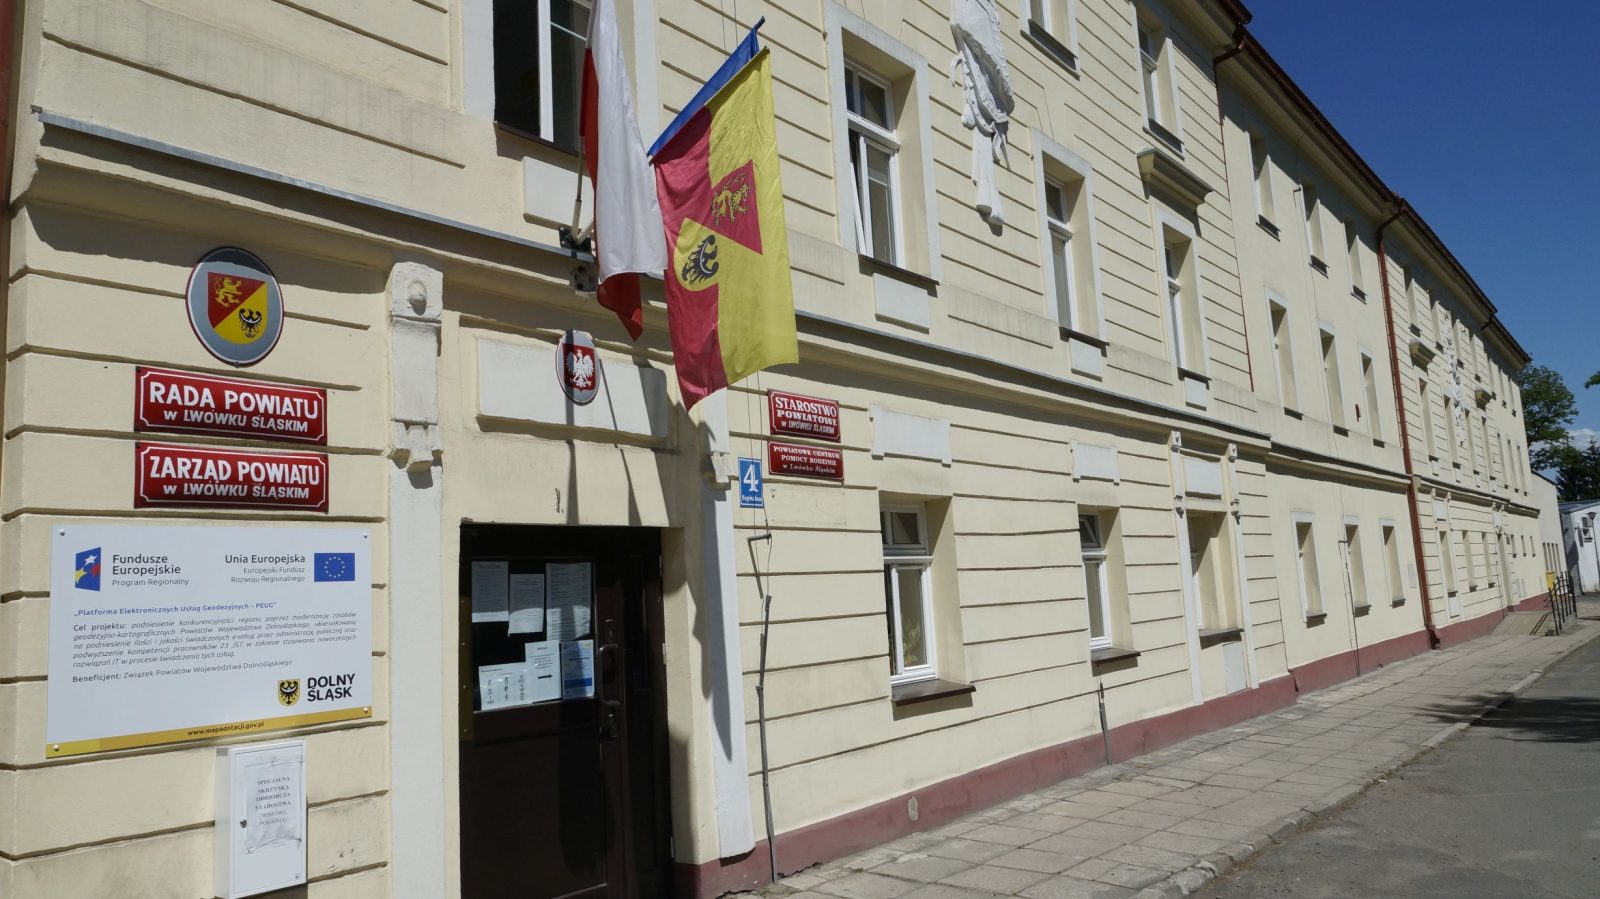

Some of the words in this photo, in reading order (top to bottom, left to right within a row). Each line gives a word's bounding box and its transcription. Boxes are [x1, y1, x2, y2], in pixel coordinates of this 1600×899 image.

[149, 381, 216, 409] RADA
[224, 390, 319, 420] POWIATU
[775, 397, 838, 418] STAROSTWO
[163, 410, 177, 421] w
[183, 408, 247, 427] LWÓWKU
[251, 414, 308, 432] ŚLĄSKIM
[776, 410, 838, 427] POWIATOWE
[788, 420, 812, 430] LWÓWKU
[813, 422, 835, 434] ŚLĄSKIM
[773, 446, 812, 456] POWIATOWE
[812, 450, 841, 460] CENTRUM
[781, 455, 808, 463] POMOCY
[810, 458, 837, 466] RODZINIE
[149, 455, 232, 484] ZARZĄD
[237, 461, 320, 486] POWIATU
[742, 464, 759, 492] 4
[814, 466, 836, 474] Śląskim
[163, 484, 177, 495] w
[183, 480, 248, 497] LWÓWKU
[252, 483, 309, 500] ŚLĄSKIM
[112, 554, 168, 564] Fundusze
[225, 554, 248, 564] Unia
[251, 554, 306, 565] Europejska
[112, 564, 182, 576] Europejskie
[112, 580, 146, 588] Program
[148, 578, 189, 586] Regionalny
[120, 606, 178, 615] Elektronicznych
[180, 604, 200, 612] Usług
[202, 604, 248, 612] Geodezyjnych
[92, 622, 126, 632] projektu:
[132, 620, 174, 630] podniesienie
[178, 618, 235, 626] konkurencyjności
[238, 616, 262, 624] regionu
[292, 612, 329, 620] modernizację
[73, 630, 176, 642] geodezyjno-kartograficznych
[218, 624, 262, 632] Województwa
[86, 640, 132, 650] podniesienie
[159, 637, 183, 646] jakości
[186, 634, 230, 642] świadczonych
[72, 650, 124, 660] podwyższenie
[128, 647, 170, 656] kompetencji
[172, 644, 218, 654] pracowników
[72, 660, 111, 668] rozwiązań
[128, 656, 158, 665] procesie
[159, 654, 200, 662] świadczenia
[201, 652, 216, 660] tych
[72, 674, 122, 683] Beneficjent:
[124, 671, 154, 679] Związek
[156, 668, 192, 676] Powiatów
[193, 663, 242, 673] Województwa
[244, 660, 293, 669] Dolnośląskiego
[307, 673, 356, 689] DOLNY
[307, 686, 352, 702] ŚLĄSK
[188, 721, 264, 736] www.mapadotacji.gov.pl
[257, 776, 290, 786] SPECJALNA
[256, 792, 291, 802] ODBIORCZA
[258, 785, 290, 794] SKRZYNKA
[256, 801, 292, 810] STAROSTWA
